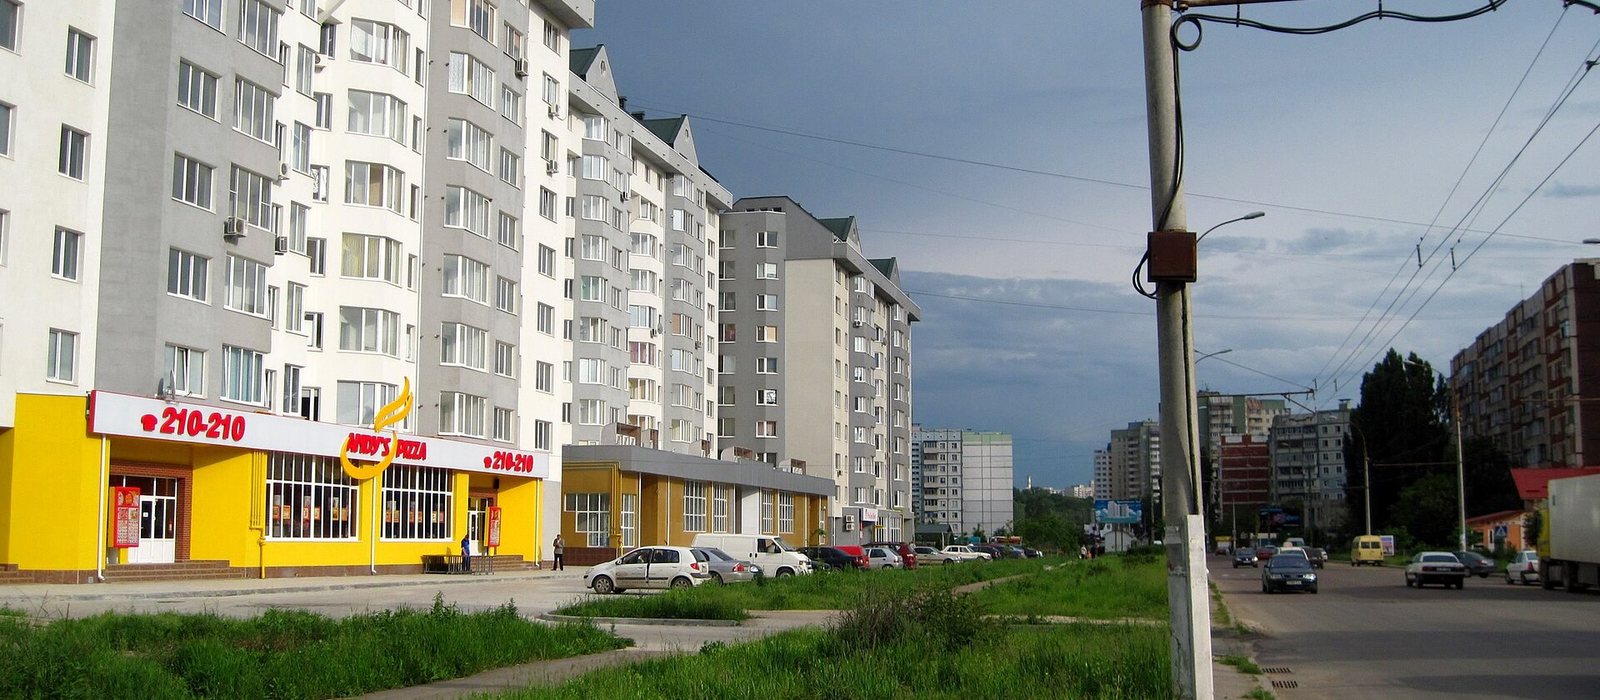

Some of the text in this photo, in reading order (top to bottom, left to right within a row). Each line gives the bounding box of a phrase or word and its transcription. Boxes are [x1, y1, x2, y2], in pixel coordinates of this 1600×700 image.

[160, 406, 246, 442] 210-210
[346, 432, 427, 462] ANDY'S PIZZA
[493, 451, 534, 473] 210-210
